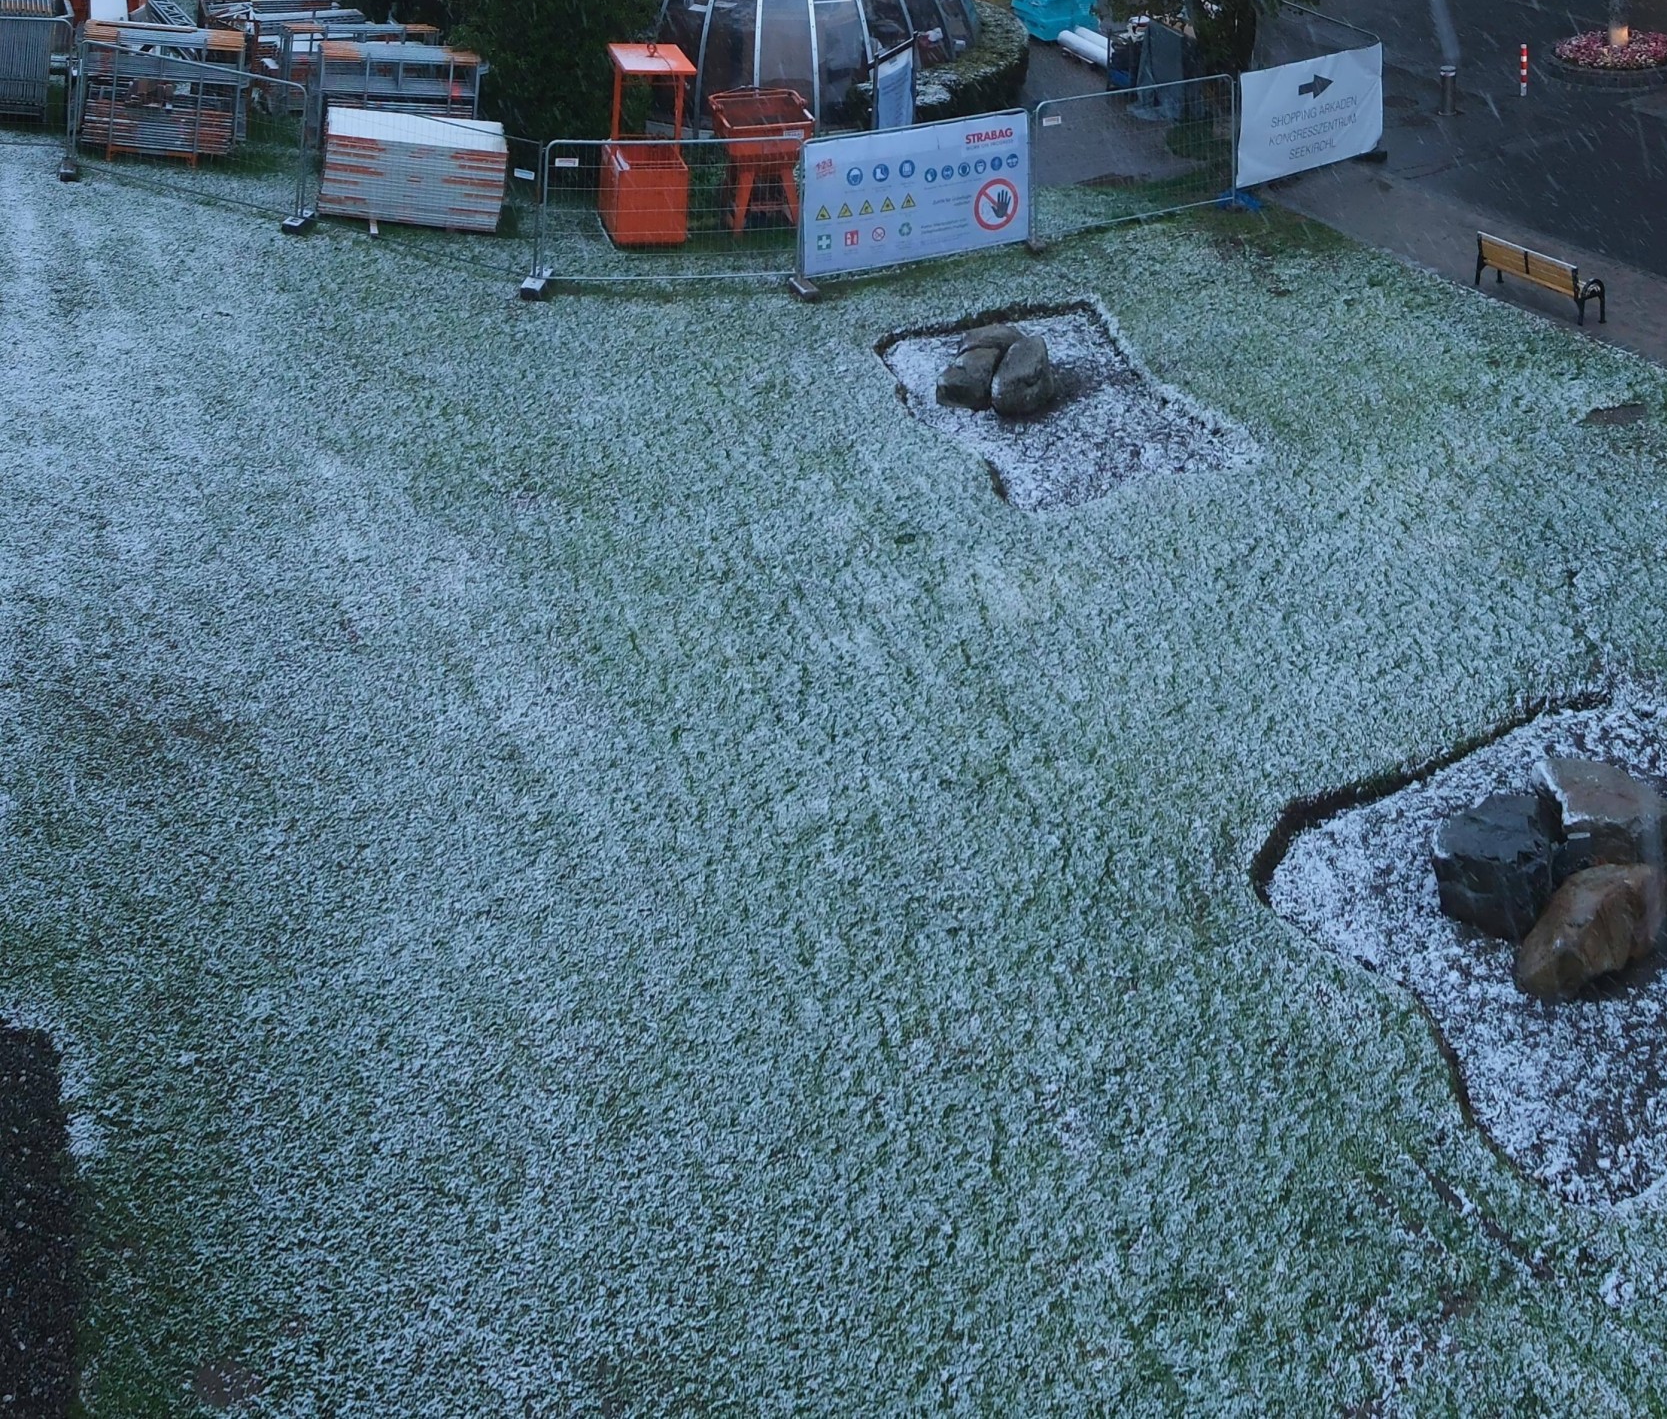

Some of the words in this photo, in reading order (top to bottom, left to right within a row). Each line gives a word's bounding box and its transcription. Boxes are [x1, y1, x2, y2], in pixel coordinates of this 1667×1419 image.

[1271, 107, 1317, 128] SHOPPING
[1319, 95, 1357, 116] ARKADEN
[965, 128, 1013, 144] STRABAG
[1268, 113, 1357, 147] KONGRESSZENTRUM
[1289, 138, 1336, 160] SEEKIRCHL
